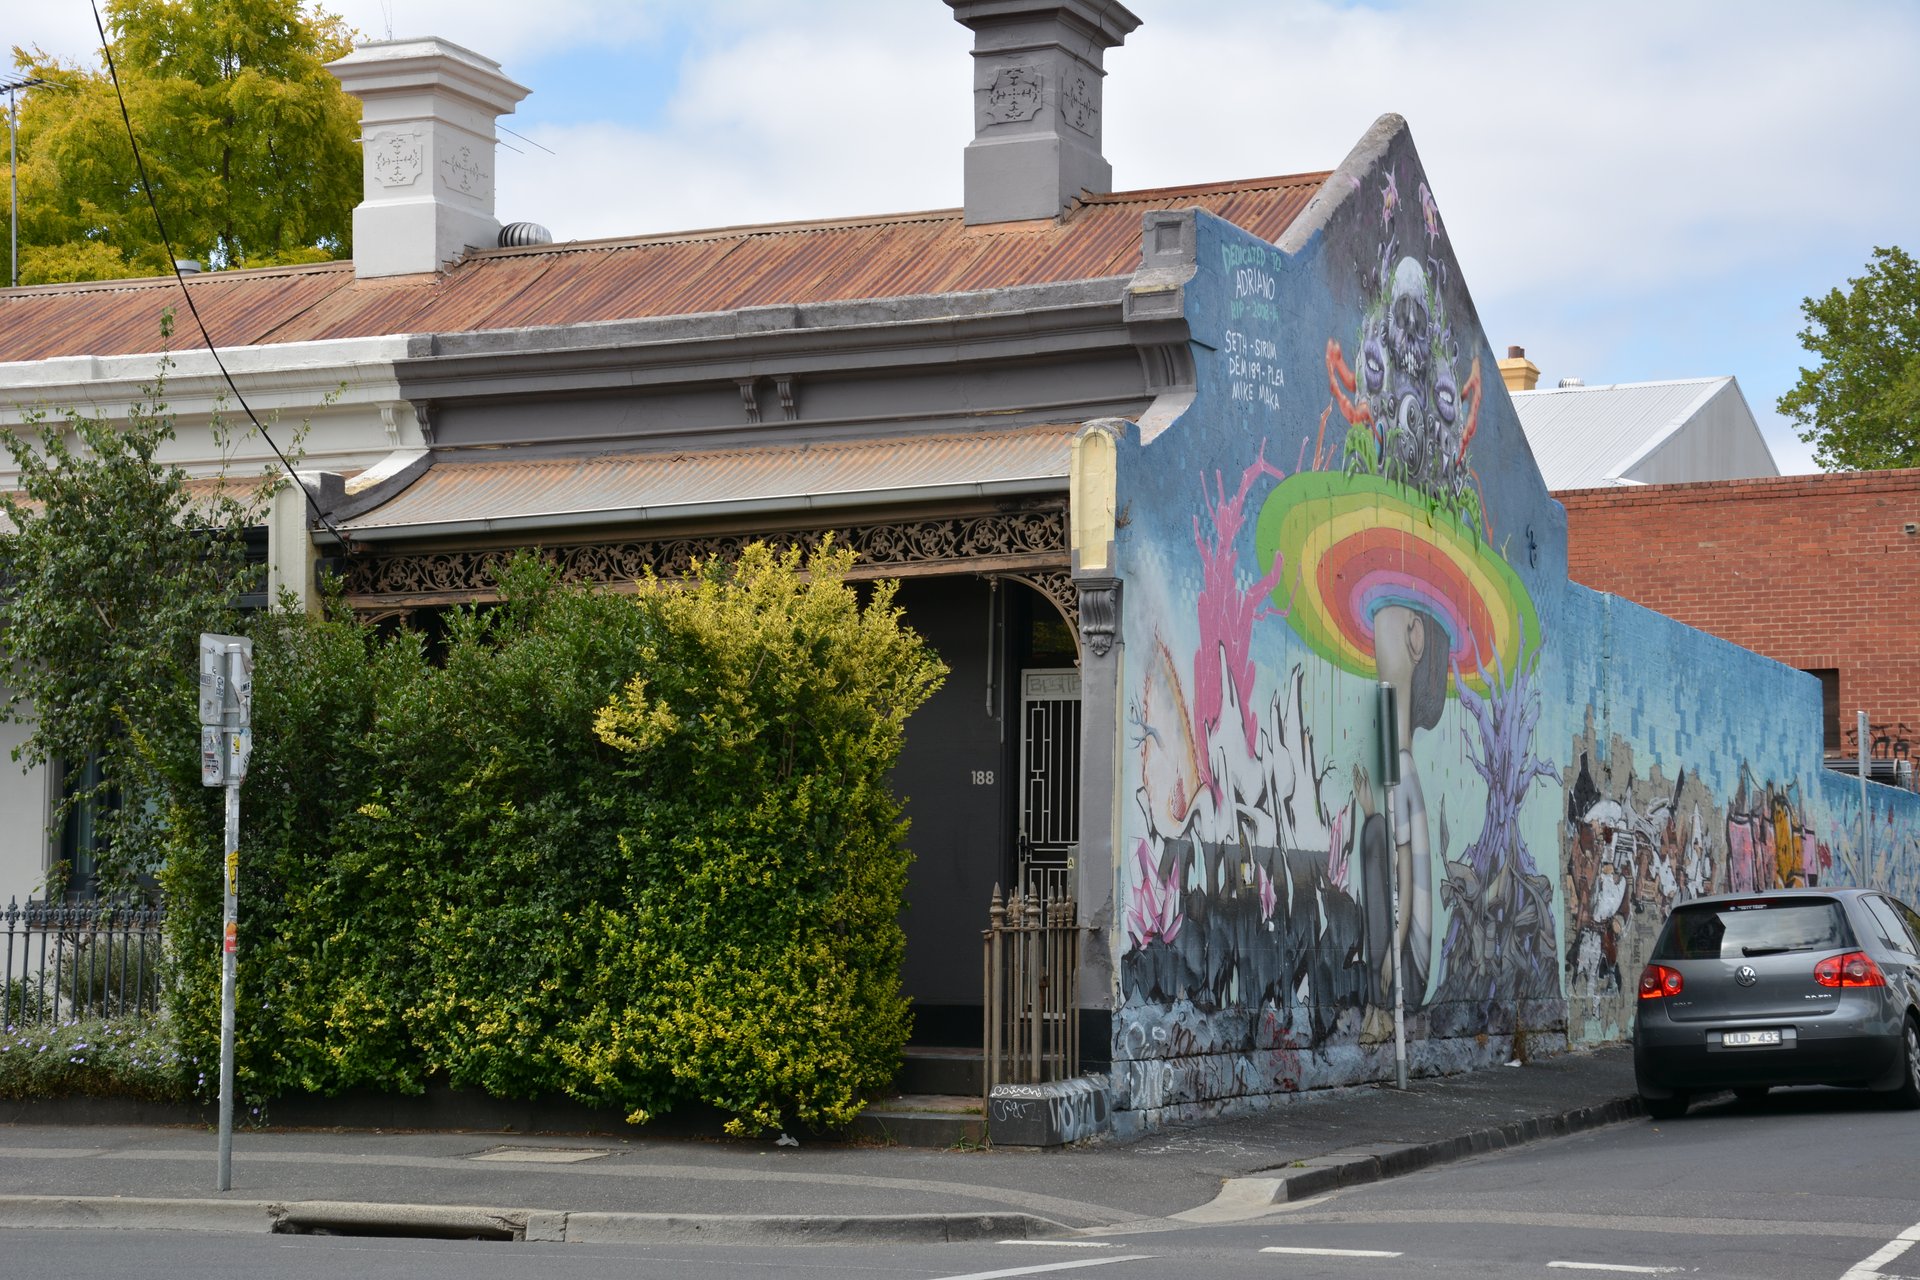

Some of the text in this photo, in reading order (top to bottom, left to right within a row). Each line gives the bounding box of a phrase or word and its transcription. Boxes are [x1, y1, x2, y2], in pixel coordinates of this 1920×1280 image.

[1222, 243, 1282, 275] DEDICATED TO
[1235, 267, 1276, 301] ADRIANO
[1231, 300, 1244, 321] RIP
[1225, 329, 1248, 357] SETH
[1231, 380, 1280, 411] MIKE MAKA
[971, 770, 995, 785] 188
